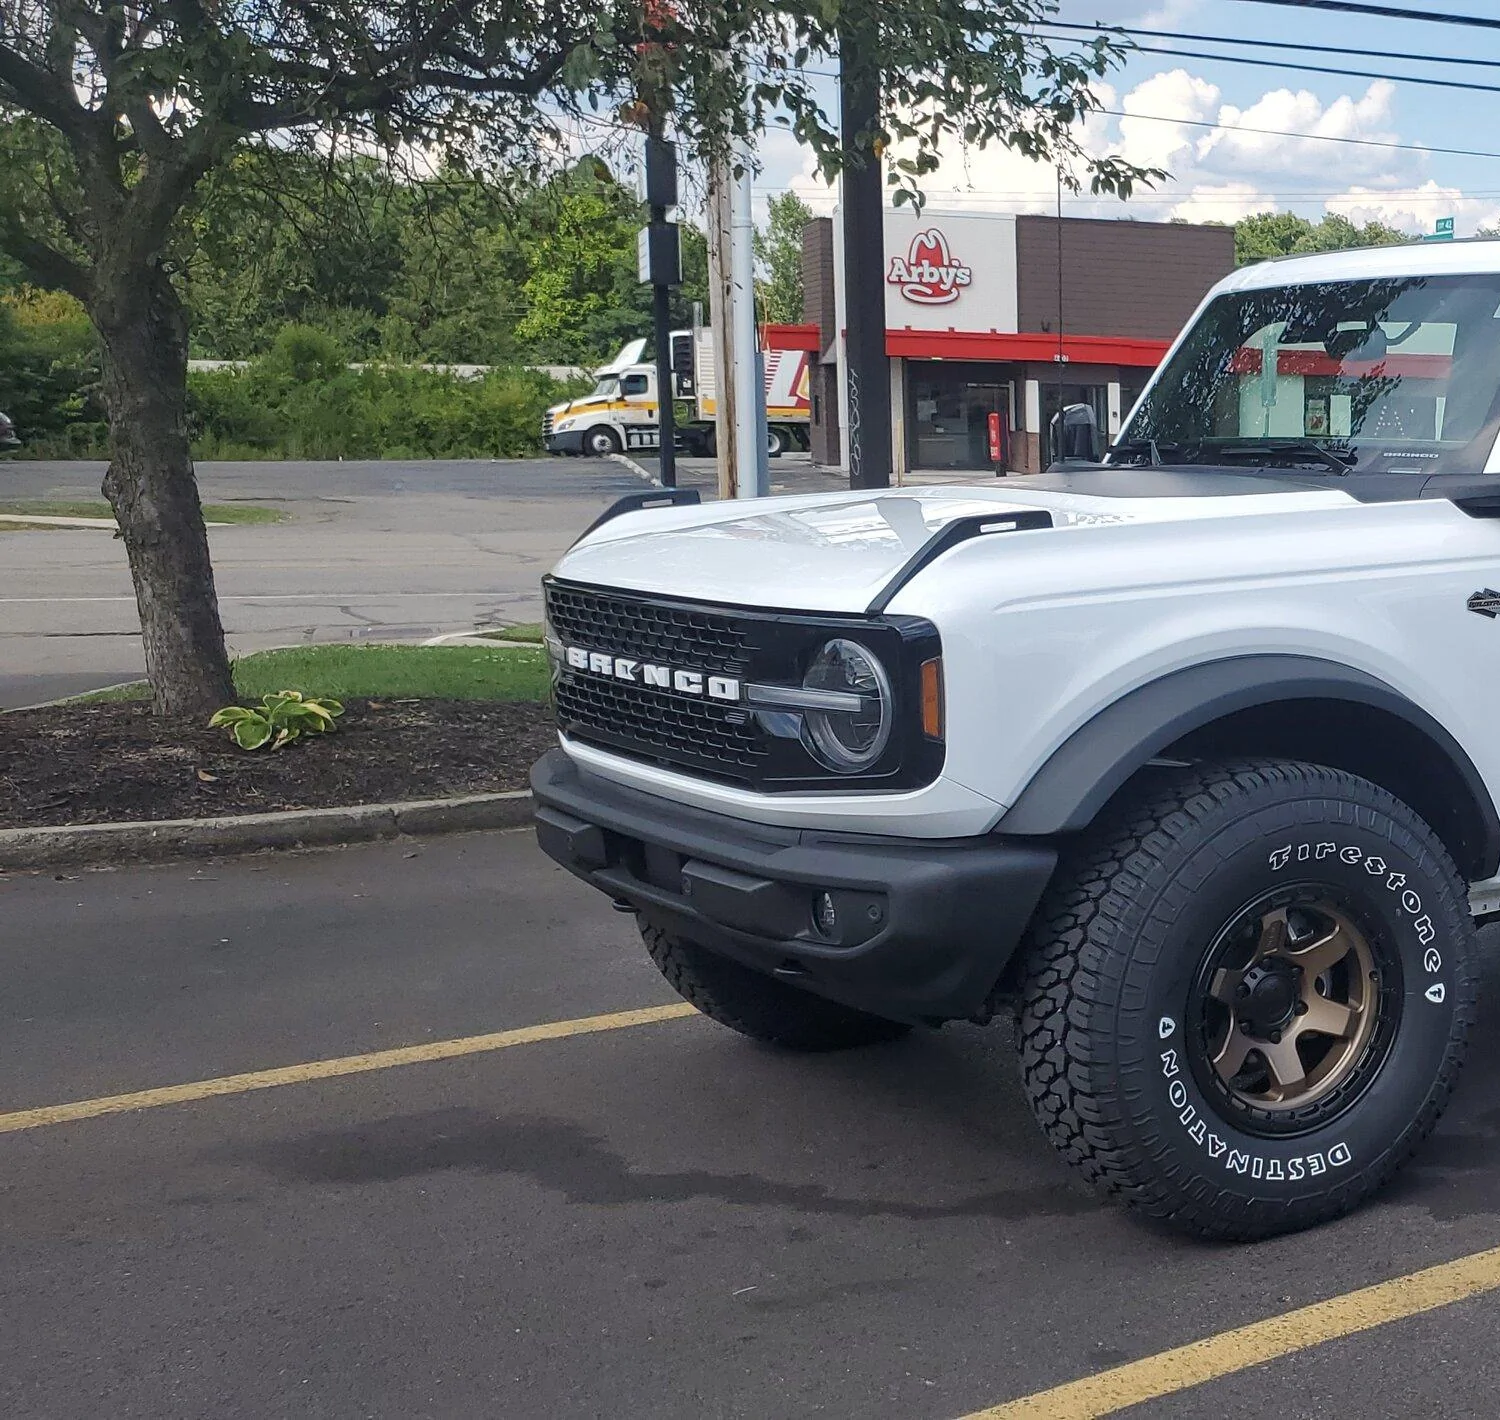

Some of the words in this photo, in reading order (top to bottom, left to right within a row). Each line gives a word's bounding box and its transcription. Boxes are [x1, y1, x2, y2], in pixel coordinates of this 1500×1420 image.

[887, 256, 972, 291] Arby's
[567, 646, 740, 701] BRONCO
[1268, 842, 1442, 972] Firestone
[1160, 1049, 1352, 1181] DESTINATION
